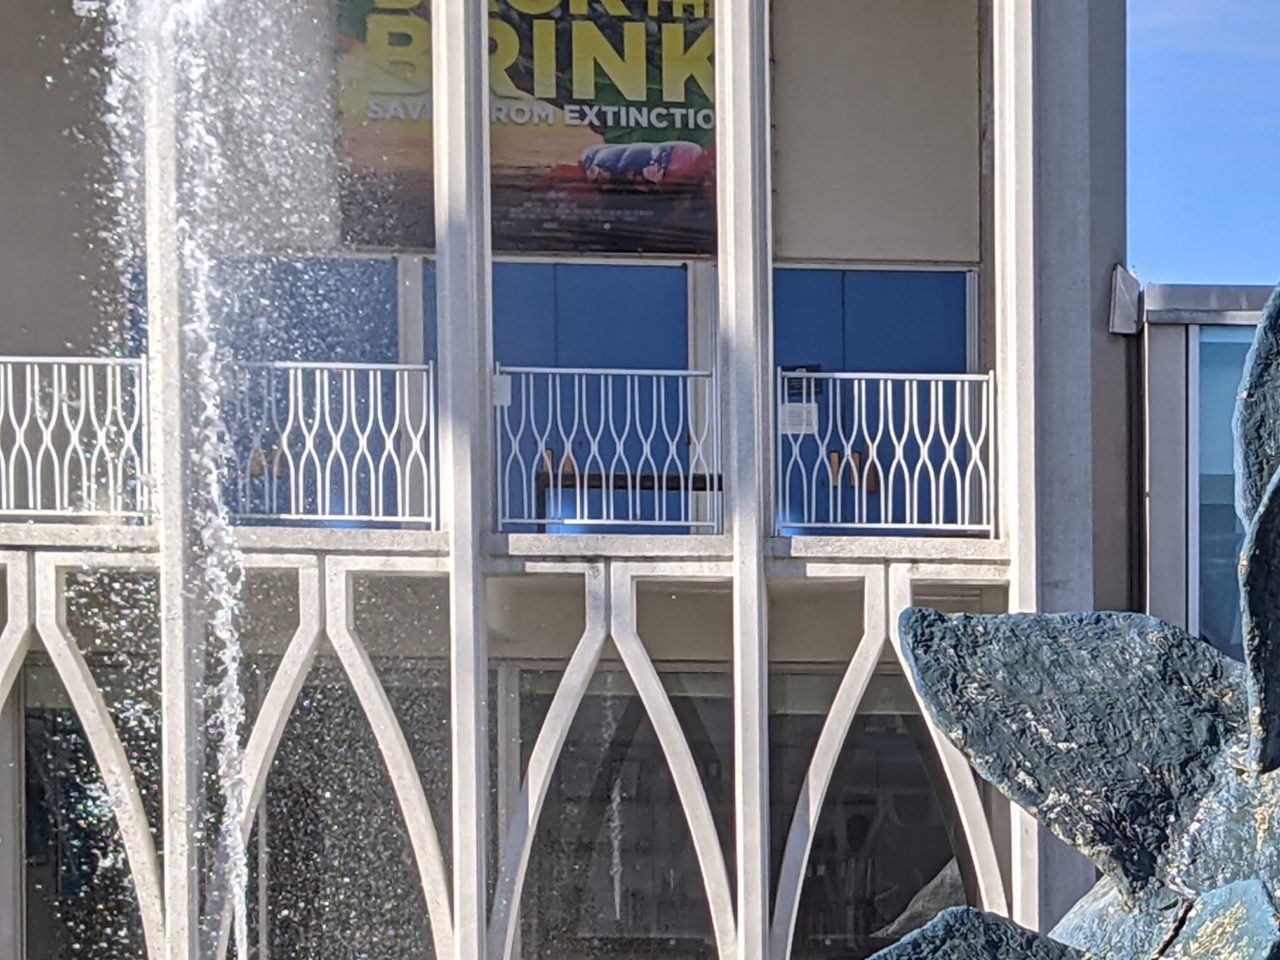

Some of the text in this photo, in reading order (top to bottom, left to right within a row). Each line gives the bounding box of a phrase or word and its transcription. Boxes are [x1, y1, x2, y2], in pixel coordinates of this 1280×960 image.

[366, 14, 715, 103] BRINK
[367, 101, 715, 129] SAV ROM EXTINCTIO
